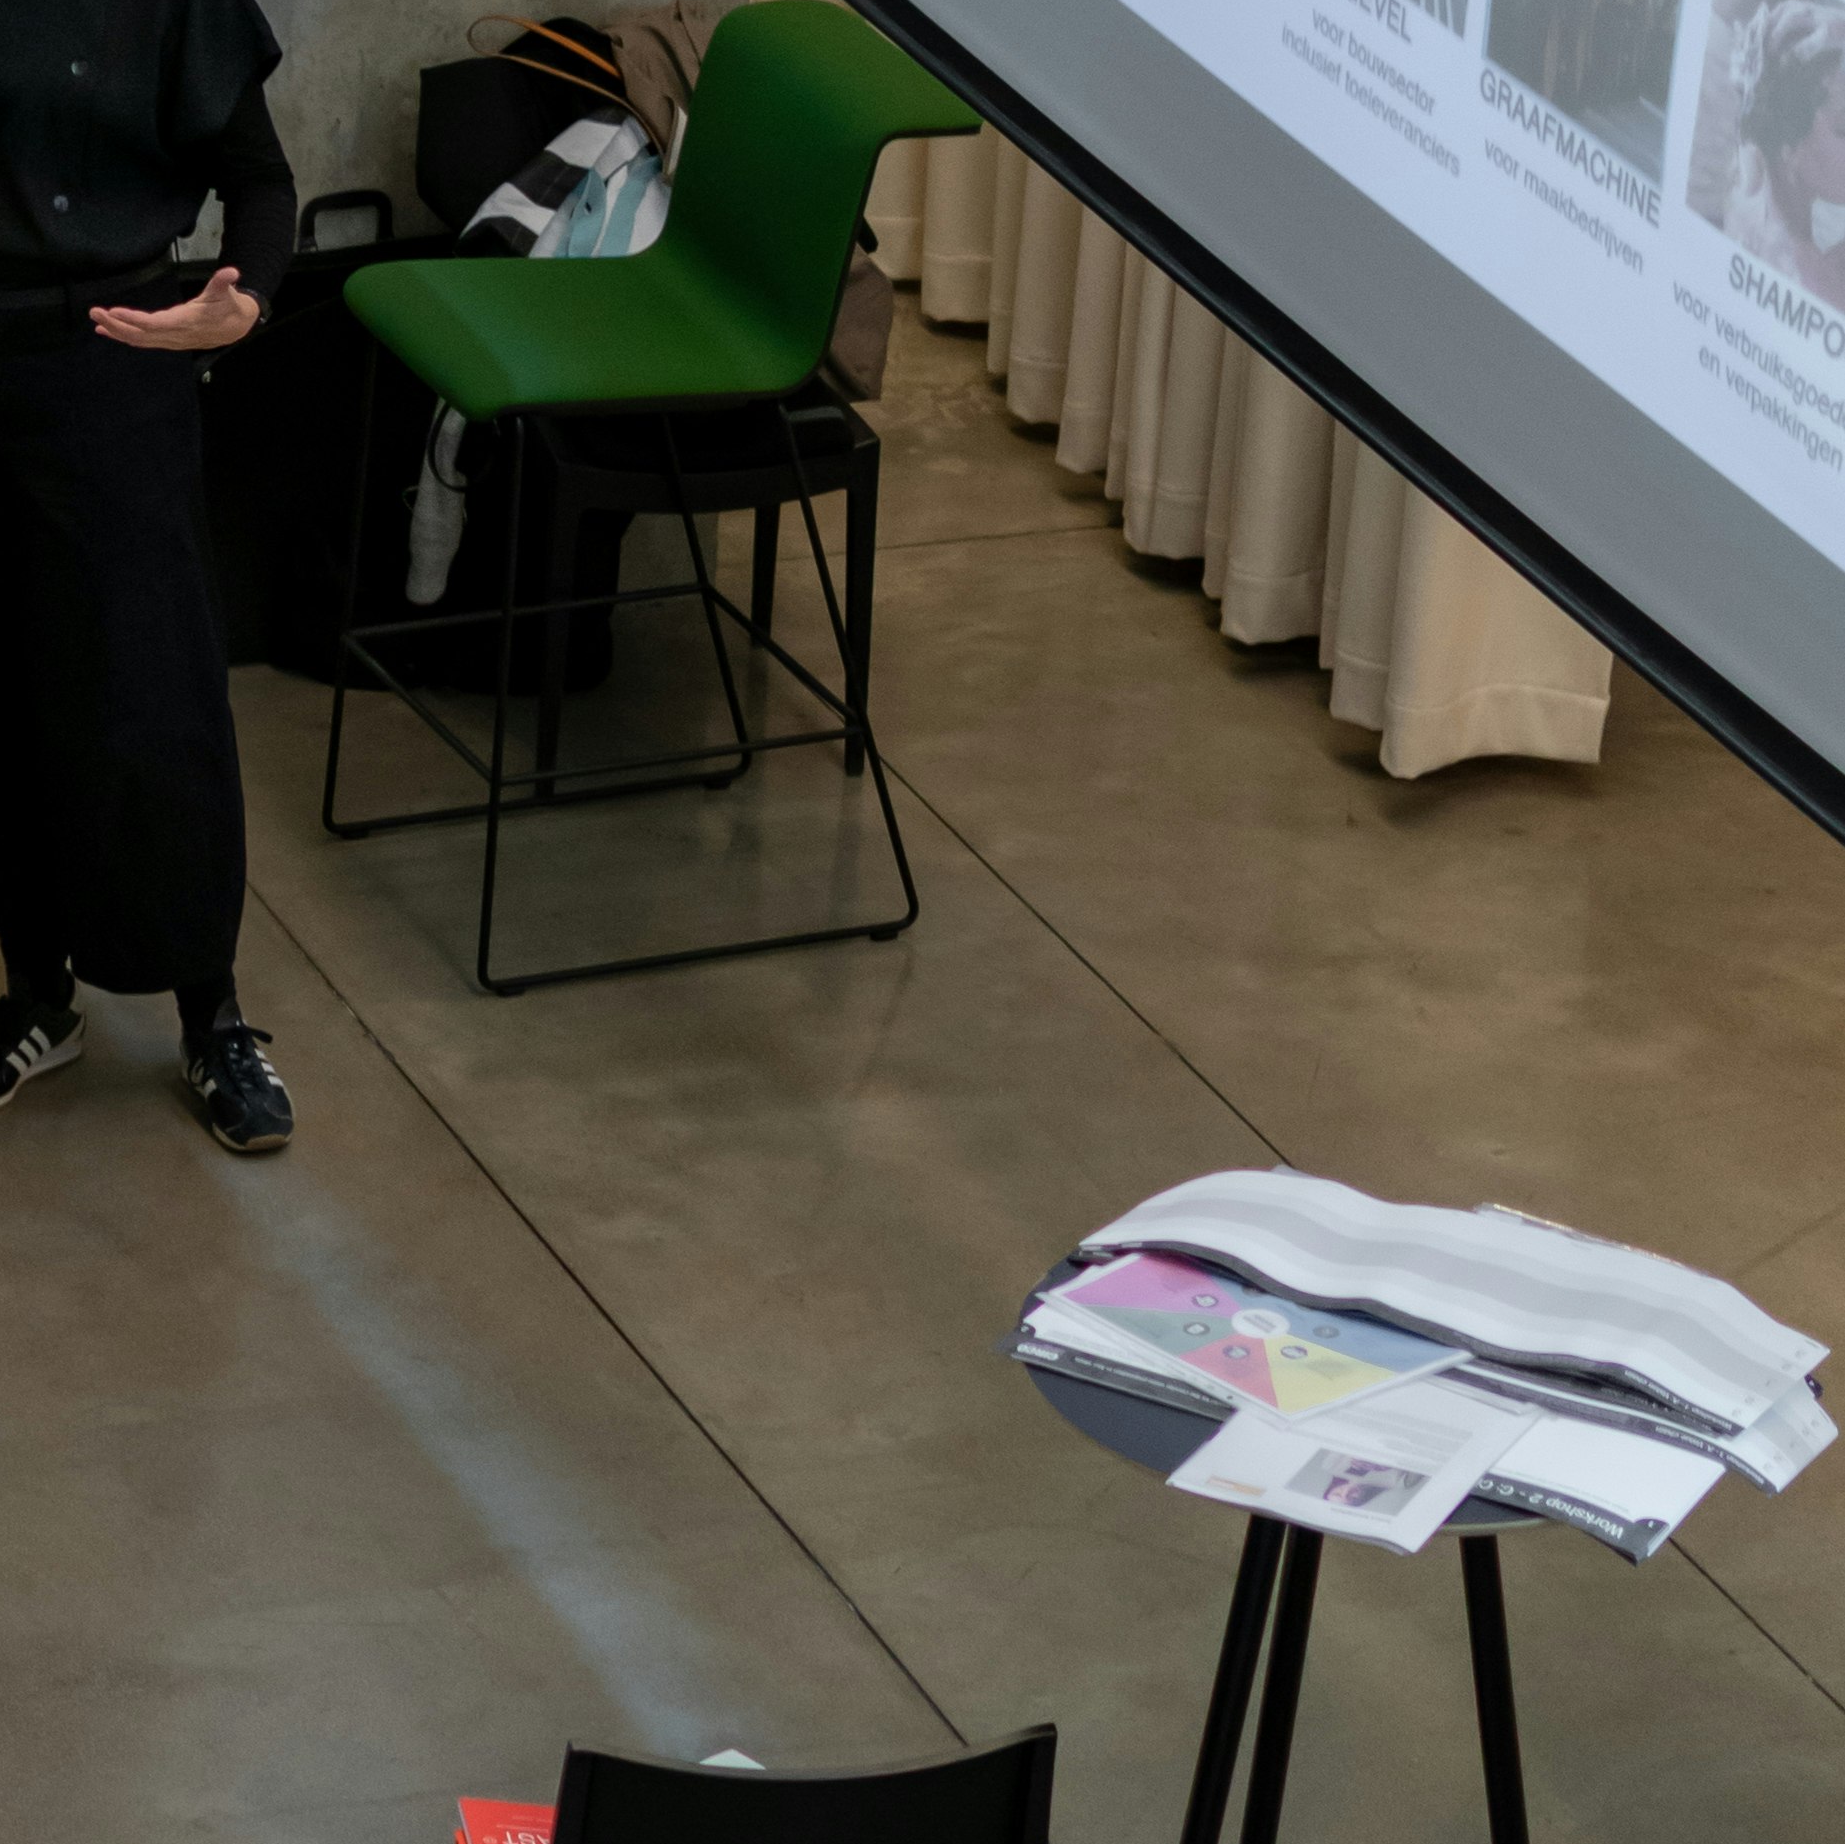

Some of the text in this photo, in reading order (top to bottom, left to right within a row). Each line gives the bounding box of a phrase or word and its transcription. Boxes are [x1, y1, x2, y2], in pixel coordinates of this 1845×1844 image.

[1280, 19, 1462, 180] inclusief toeleveranciers
[1312, 6, 1436, 117] voor bouwsector
[1480, 67, 1662, 231] GRAAFMACHINE
[1484, 135, 1645, 276] voor maakbedrijven
[1673, 278, 1711, 326] voor
[1698, 345, 1843, 473] en verpakkingen
[1529, 1492, 1544, 1505] 2
[1546, 1497, 1624, 1540] Workshop
